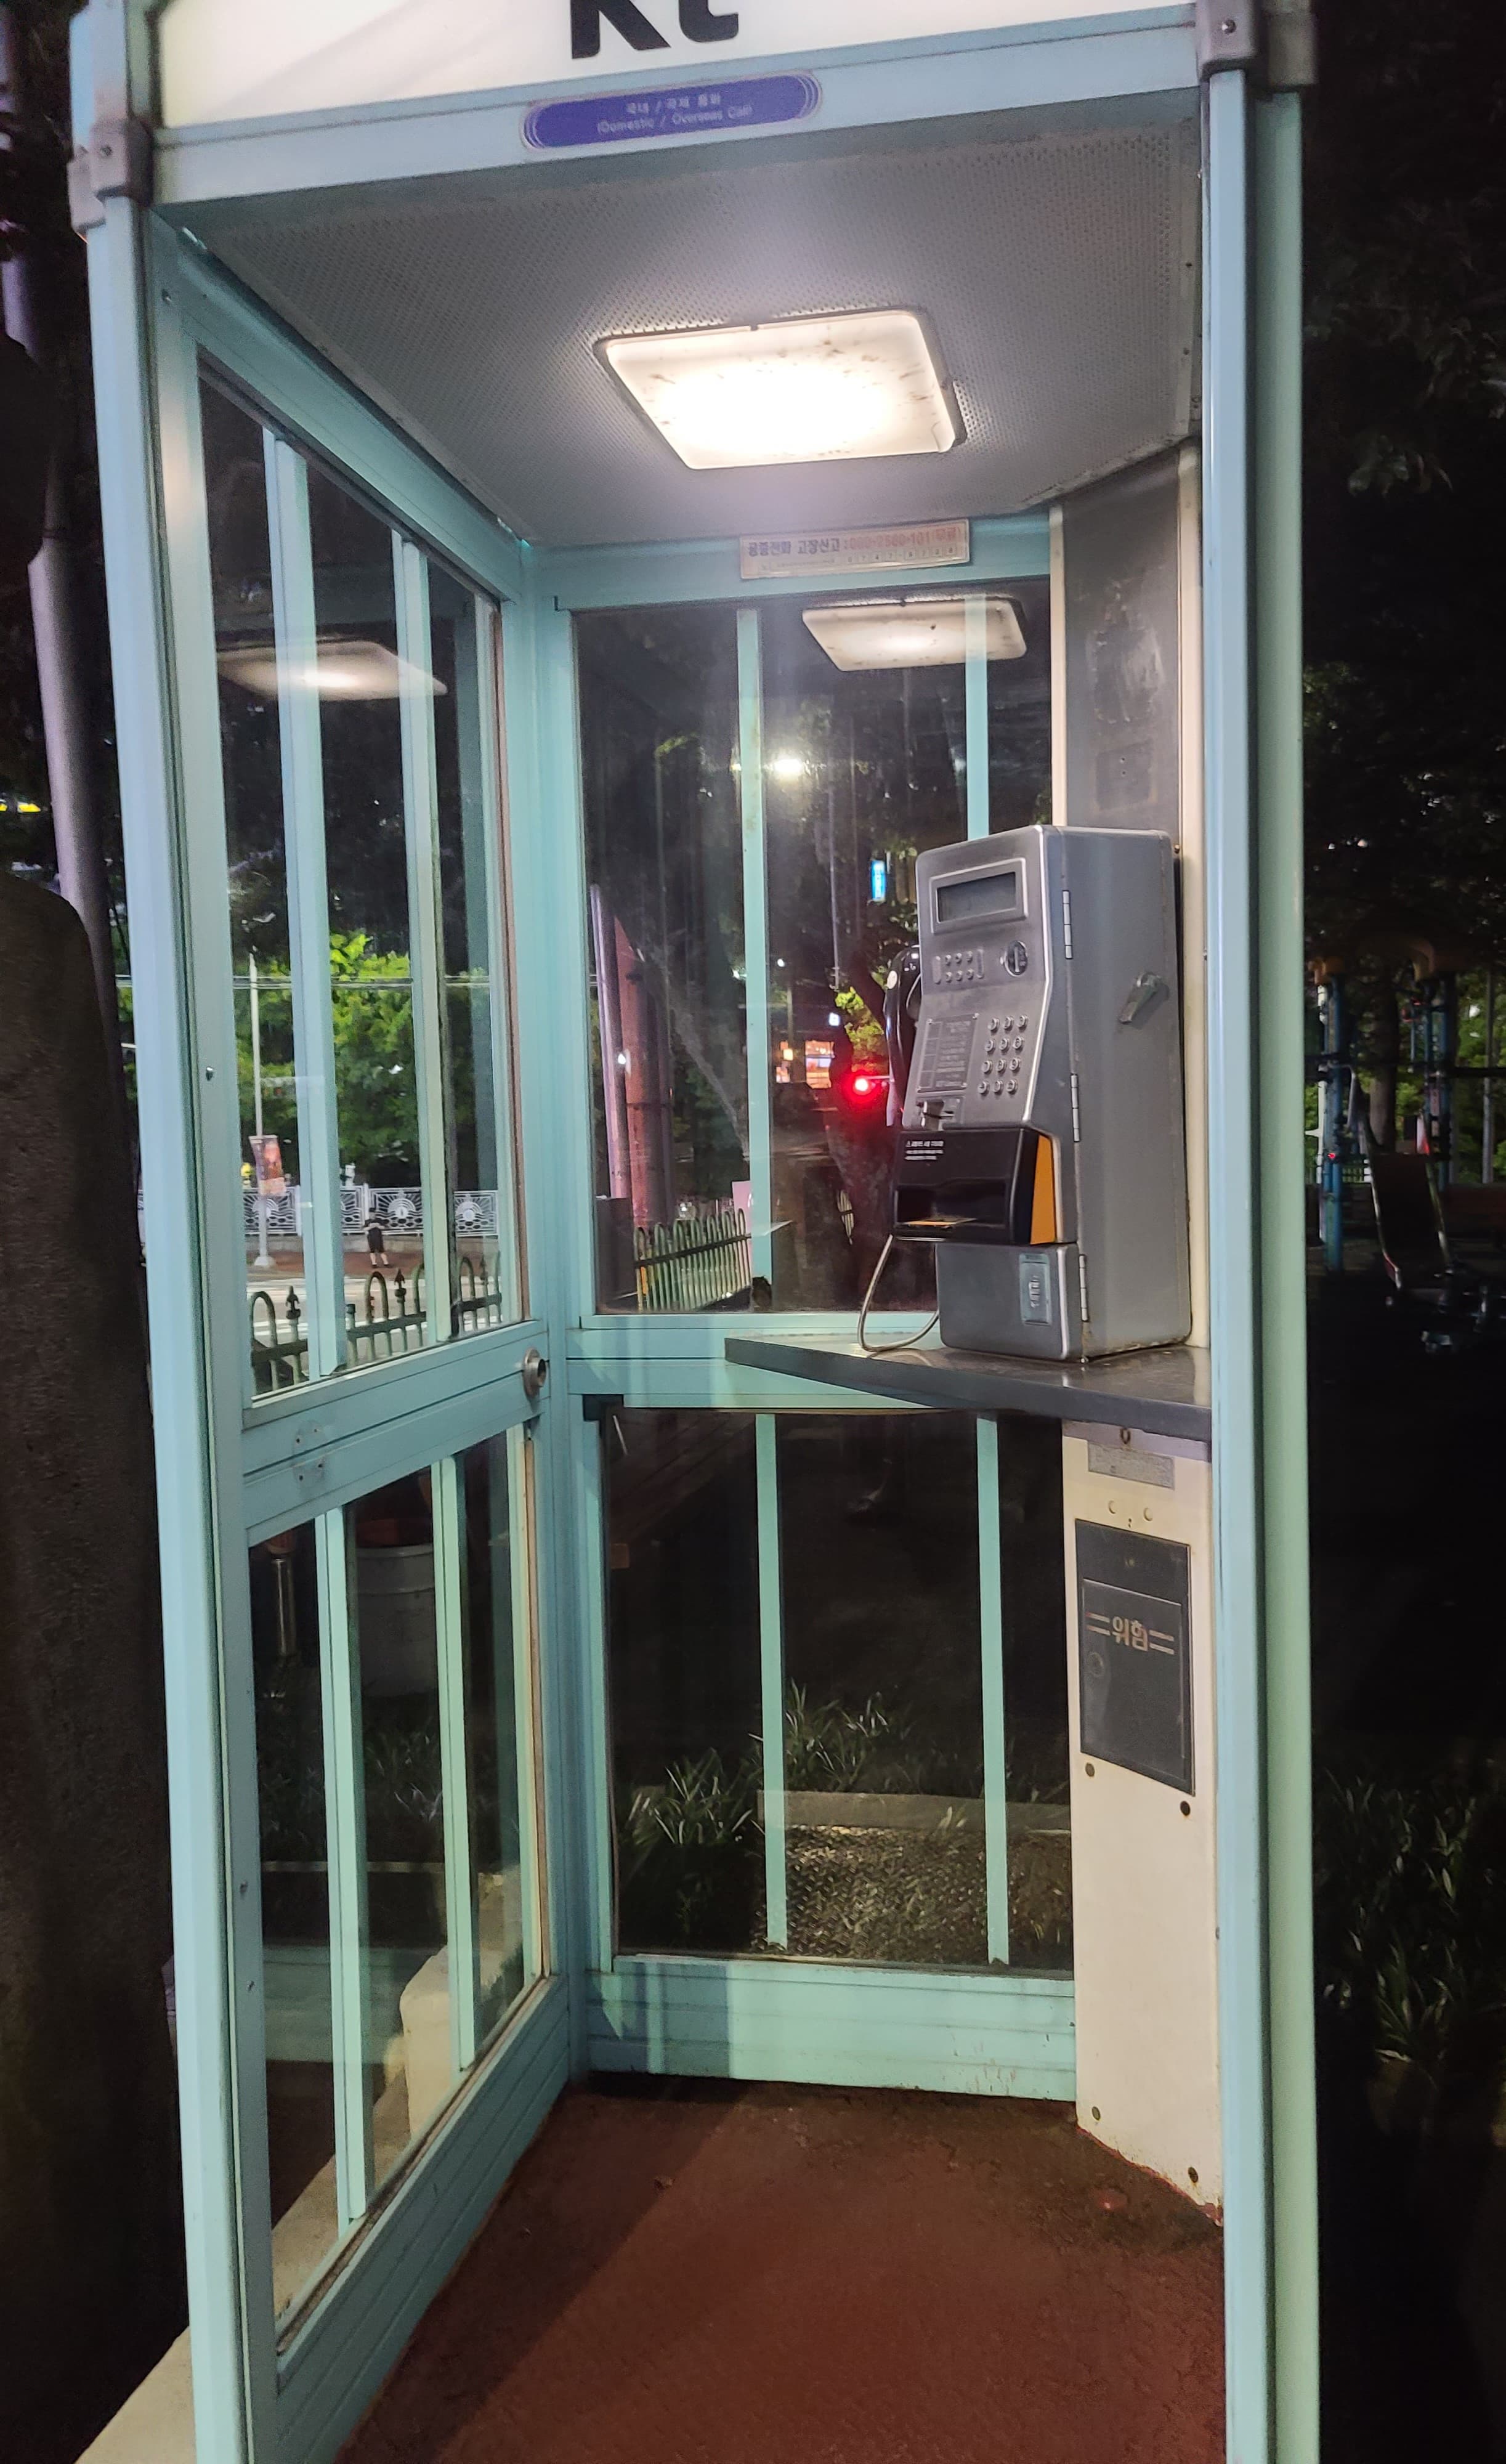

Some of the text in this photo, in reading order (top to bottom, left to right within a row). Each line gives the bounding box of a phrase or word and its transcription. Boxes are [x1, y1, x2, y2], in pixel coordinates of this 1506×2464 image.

[748, 541, 791, 557] 공중전화
[798, 537, 840, 554] 고장신고
[1112, 1616, 1149, 1651] 위험
